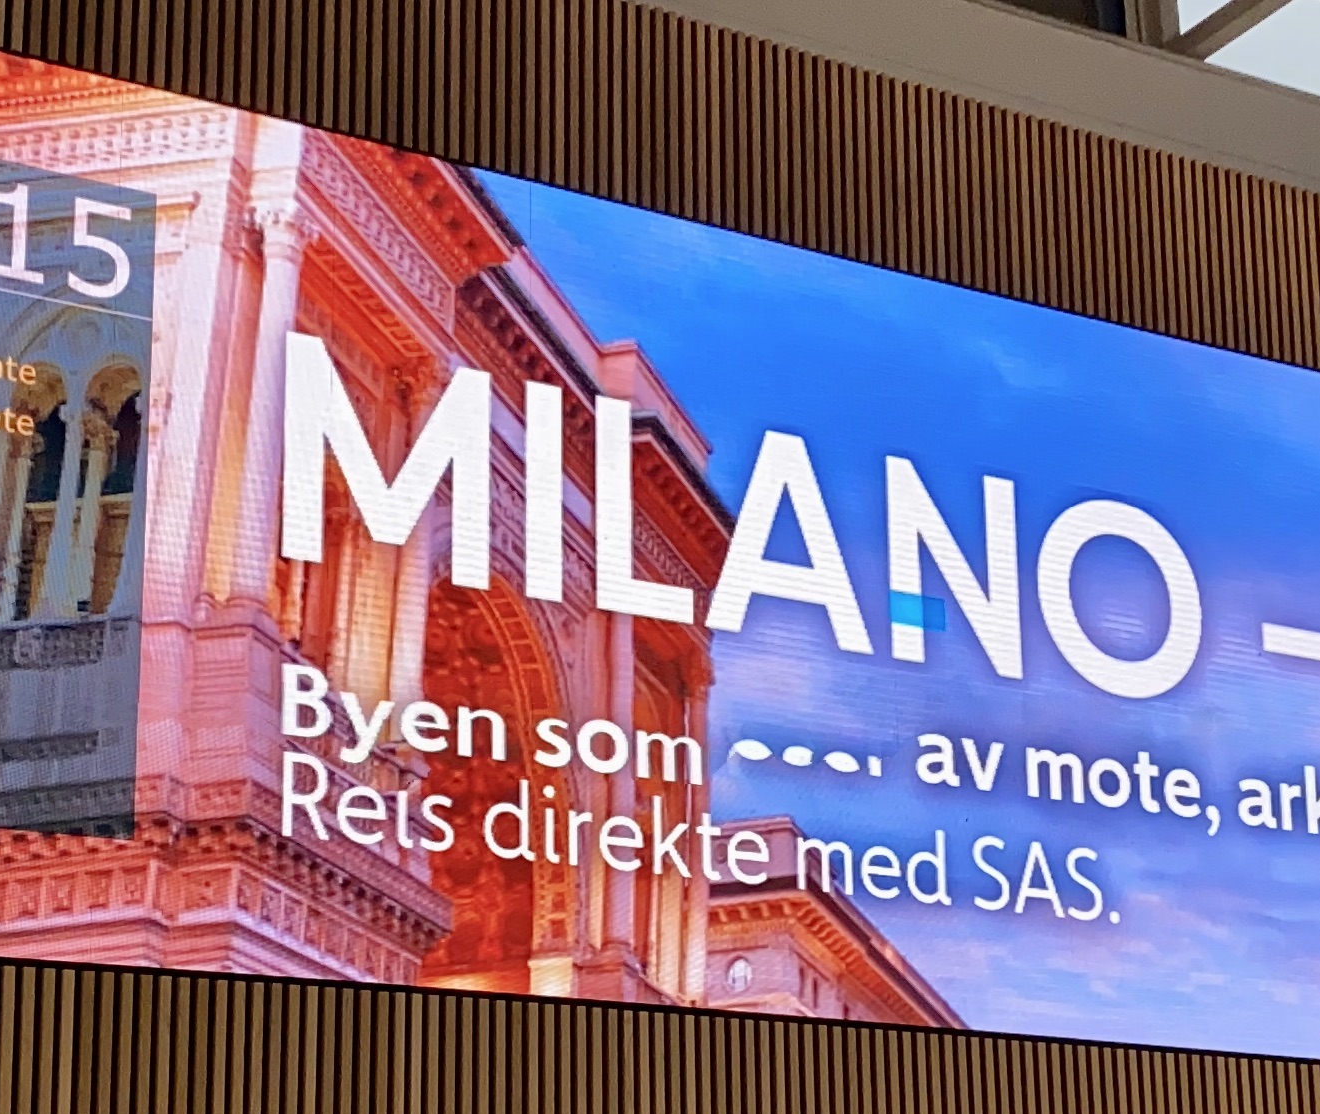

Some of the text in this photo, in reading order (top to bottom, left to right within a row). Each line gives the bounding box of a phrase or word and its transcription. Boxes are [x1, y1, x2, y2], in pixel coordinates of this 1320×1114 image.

[279, 330, 1202, 700] MILANO
[279, 661, 508, 763] Byen
[534, 716, 704, 787] som
[914, 733, 1004, 795] av
[1025, 747, 1222, 838] mote,
[279, 749, 1123, 926] Reis direkte med SAS.
